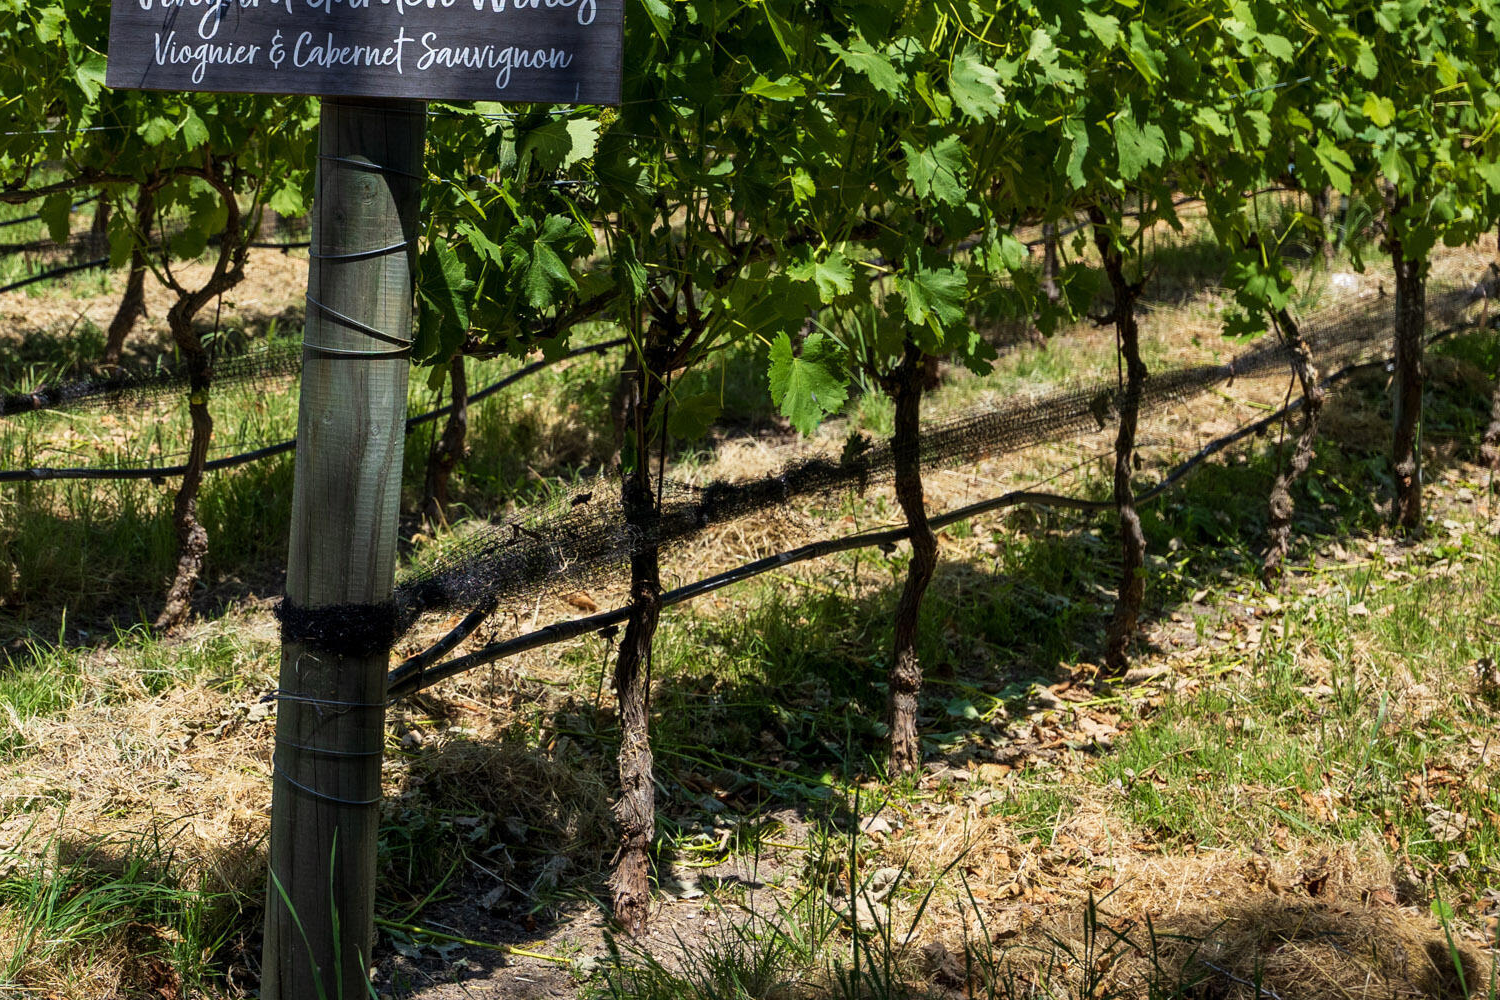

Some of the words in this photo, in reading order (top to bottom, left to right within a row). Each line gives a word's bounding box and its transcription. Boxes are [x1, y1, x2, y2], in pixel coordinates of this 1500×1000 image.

[155, 30, 260, 84] Viognier
[270, 29, 285, 69] &
[294, 26, 414, 74] Cabernet
[417, 31, 573, 89] Sauvignon
